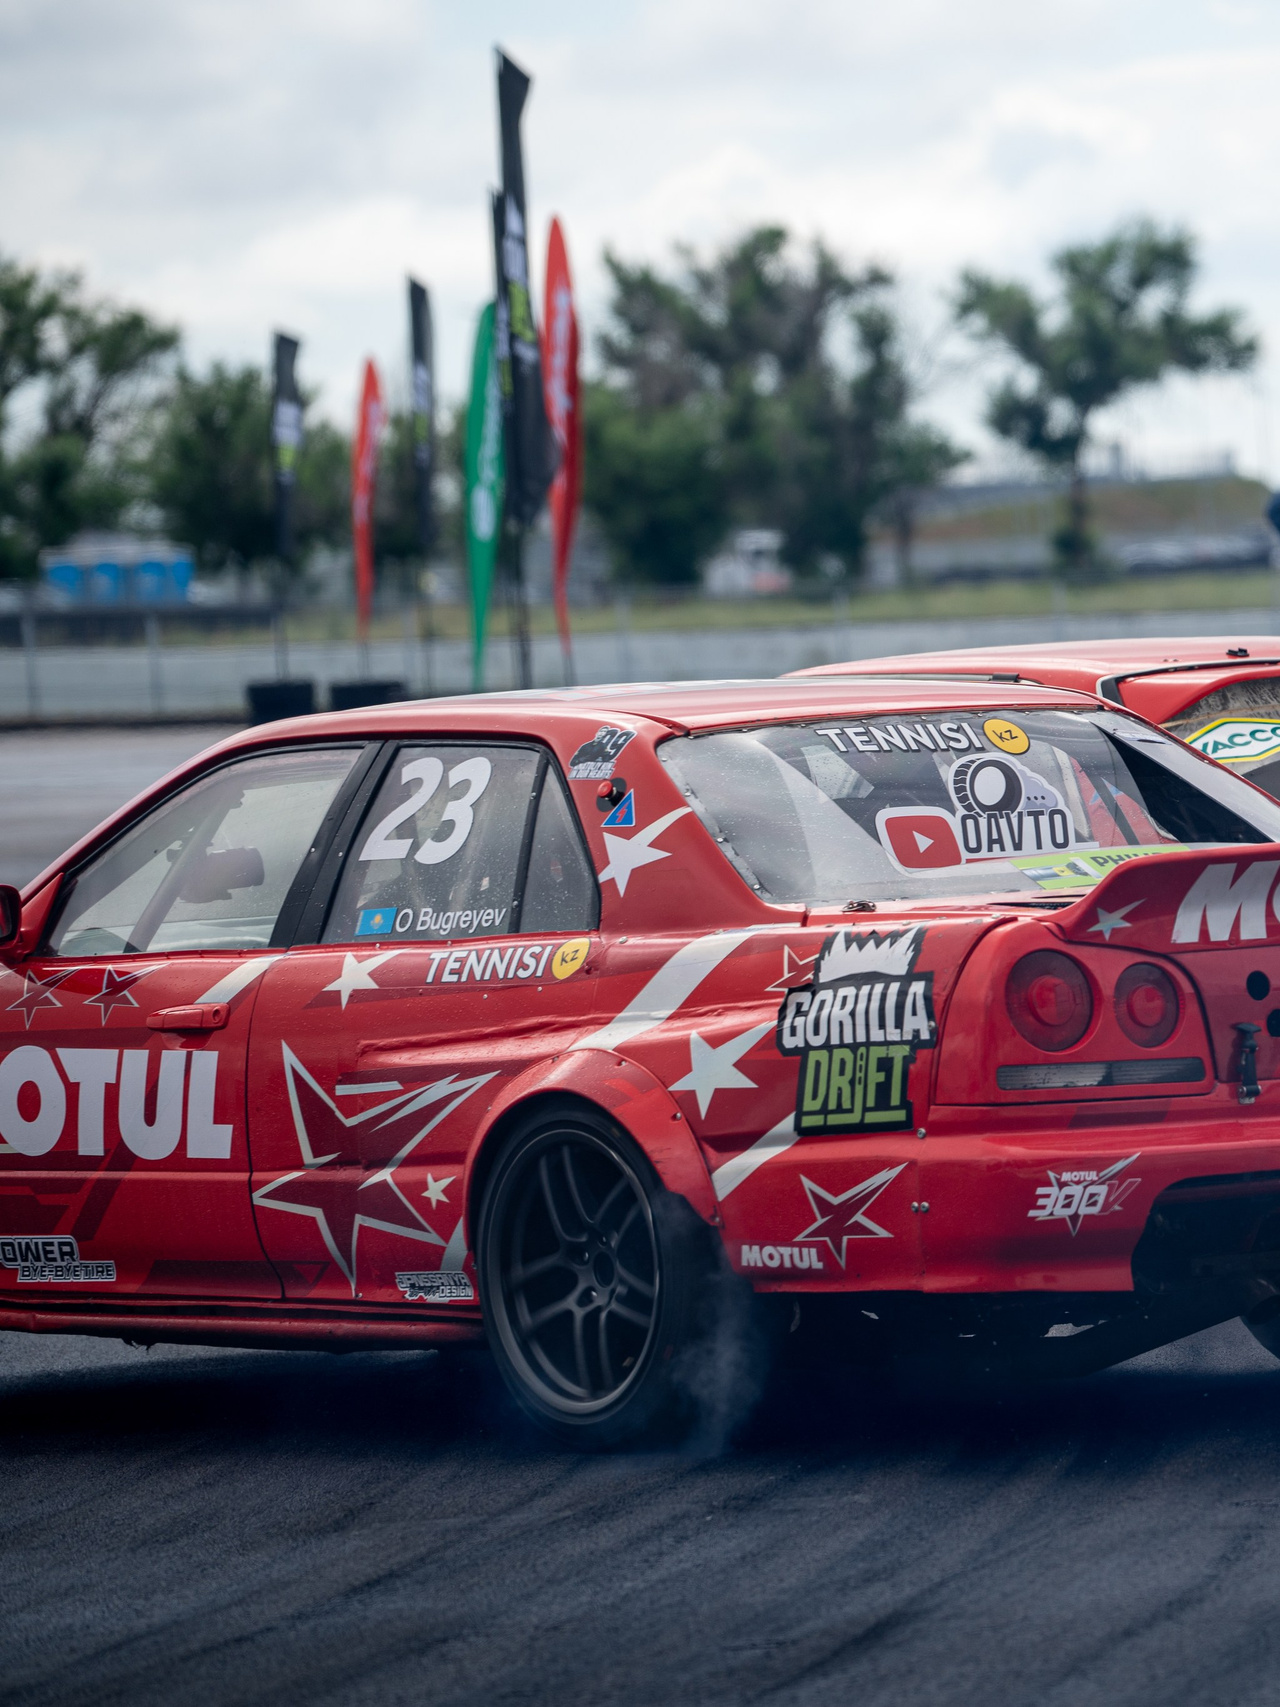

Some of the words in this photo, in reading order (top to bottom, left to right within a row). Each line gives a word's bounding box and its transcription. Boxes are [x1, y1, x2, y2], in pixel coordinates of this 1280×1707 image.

[816, 722, 983, 752] TENNISI
[358, 757, 492, 865] 23
[961, 808, 1069, 854] OAVTO
[395, 908, 413, 933] O
[416, 907, 507, 935] Bugreyev
[426, 945, 552, 983] TENNISI
[782, 981, 930, 1049] GORILLA
[0, 1045, 233, 1160] OTUL
[801, 1045, 910, 1126] DRIFT
[1061, 1171, 1099, 1182] MOTUL
[0, 1241, 76, 1262] OWER
[741, 1245, 824, 1269] MOTUL
[440, 1285, 472, 1298] DESIGN
